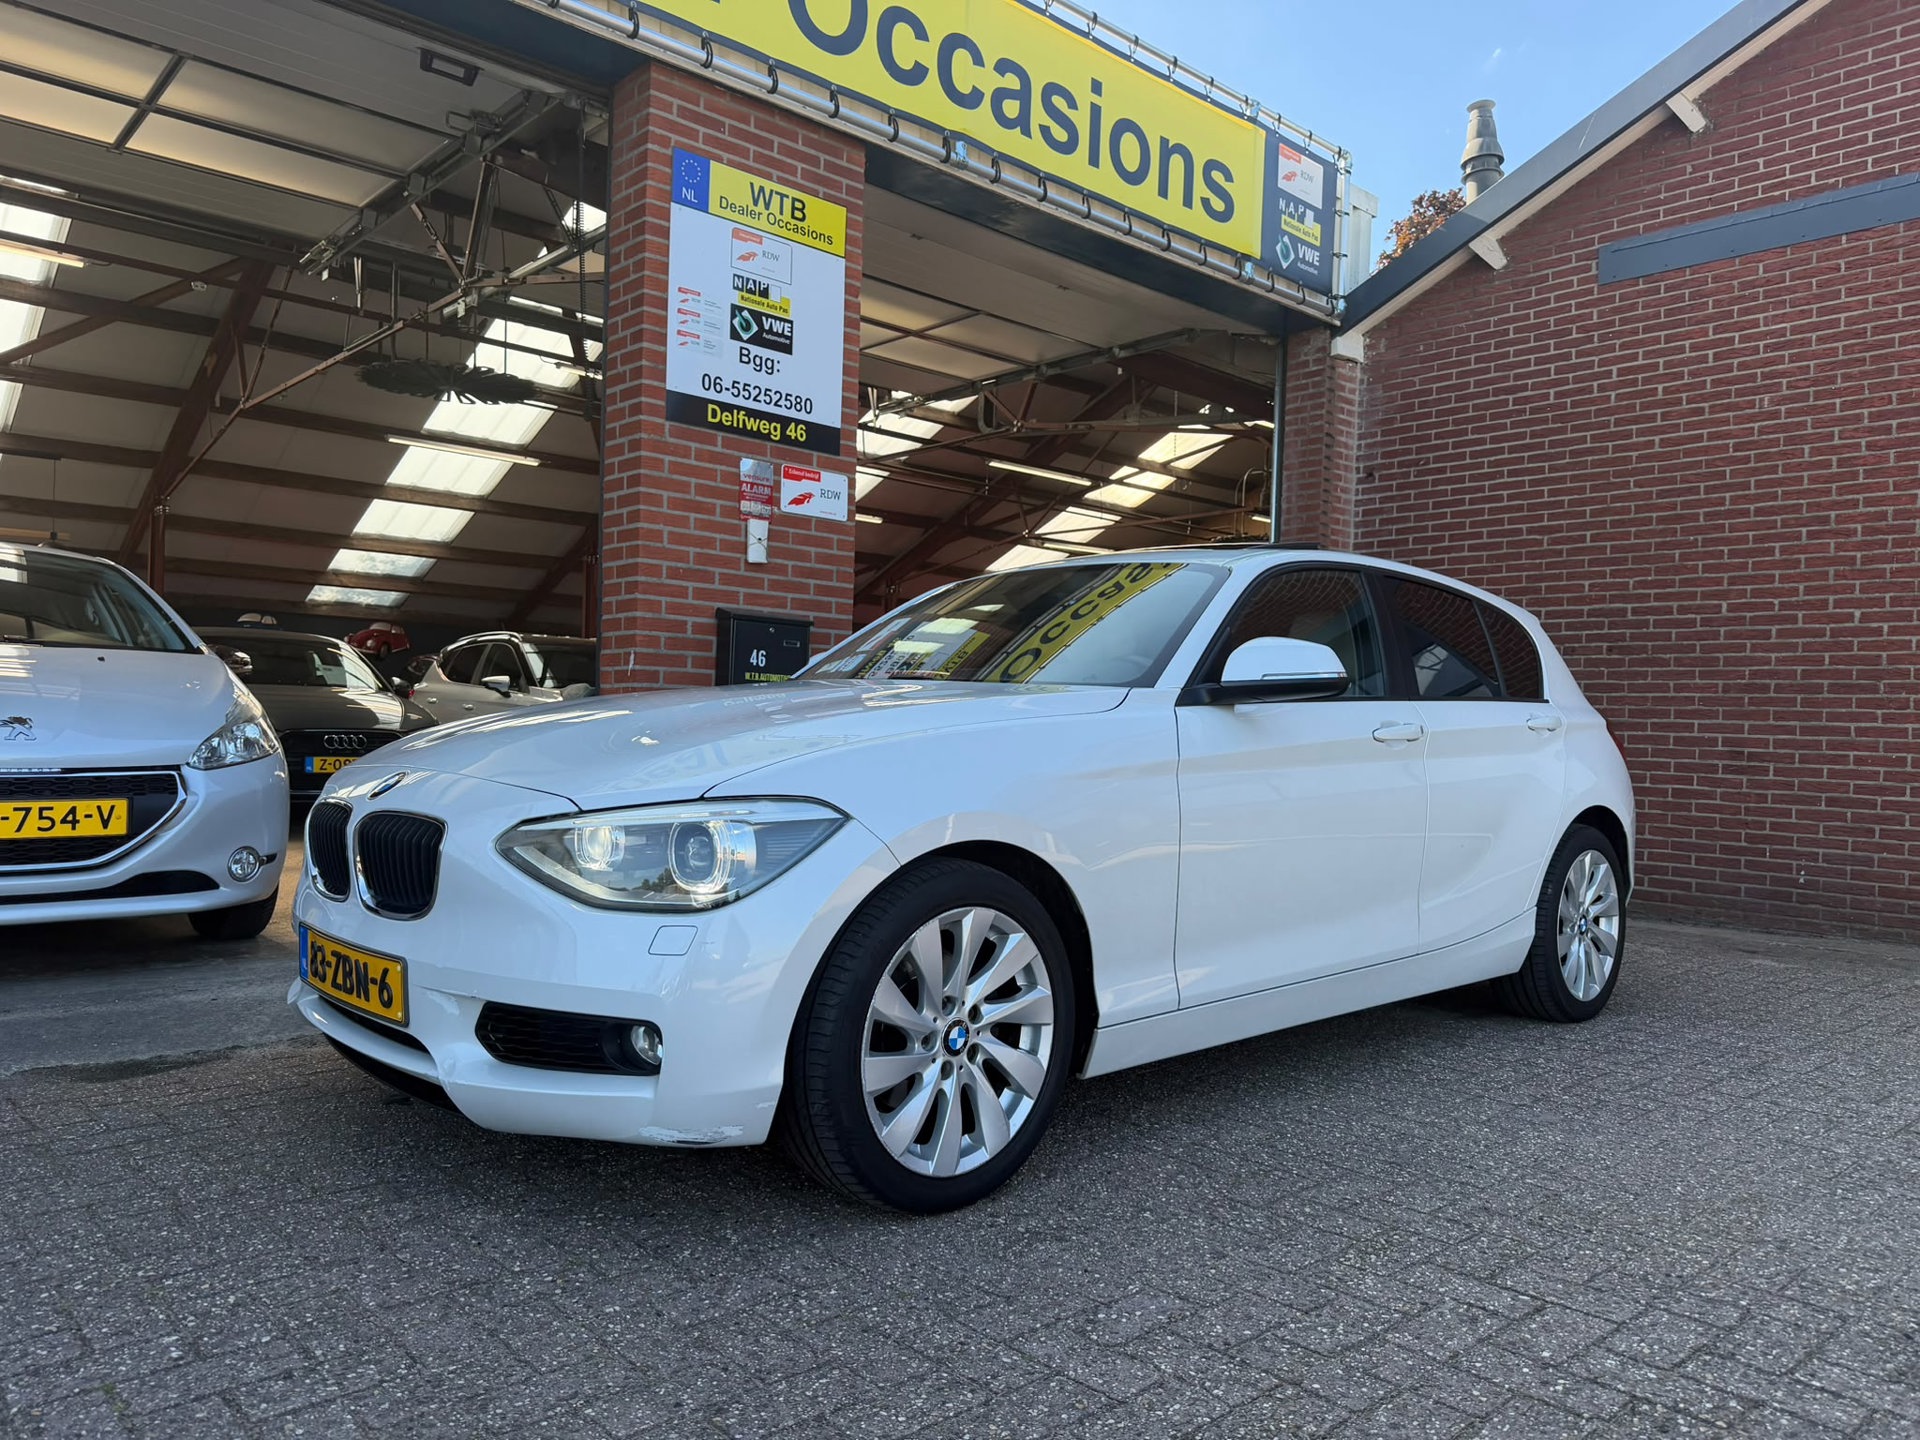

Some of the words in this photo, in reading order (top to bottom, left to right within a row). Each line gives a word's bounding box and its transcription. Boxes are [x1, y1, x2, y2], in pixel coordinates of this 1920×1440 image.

[682, 187, 698, 203] NL
[750, 182, 807, 222] WTB
[719, 196, 763, 221] Dealer
[767, 213, 833, 246] Occasions
[762, 250, 780, 262] RDW
[1298, 243, 1320, 266] VWE
[734, 275, 768, 291] NAP
[740, 294, 765, 307] Nationale
[766, 301, 778, 311] Auto
[778, 304, 789, 314] Pas
[762, 316, 791, 336] VWE
[762, 333, 790, 345] Automotive
[739, 346, 780, 375] Bgg:
[702, 373, 813, 414] 06-55252580
[707, 403, 781, 441] Delfweg
[786, 422, 807, 441] 46
[741, 483, 771, 496] ALARM
[820, 488, 841, 501] RDW
[750, 649, 767, 667] 46
